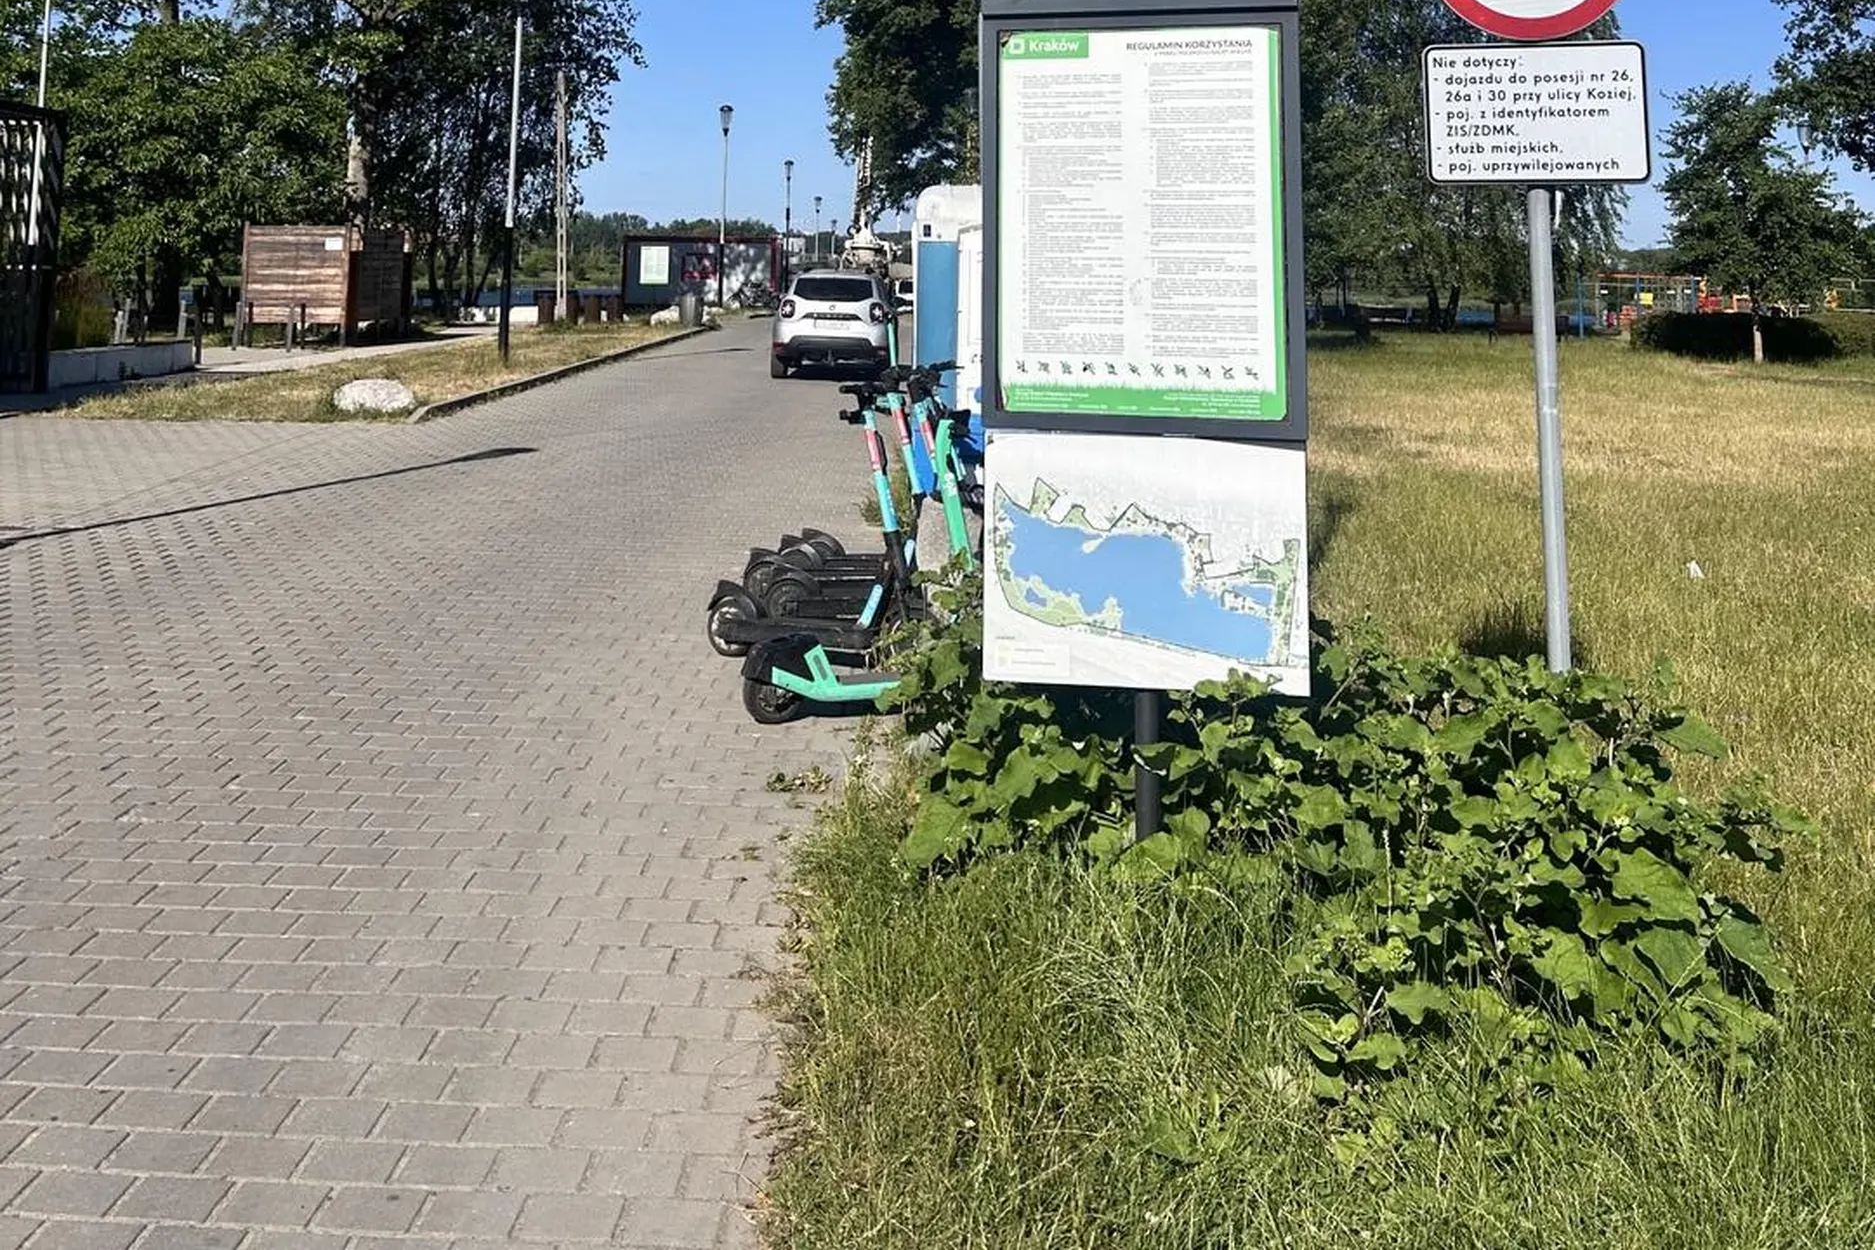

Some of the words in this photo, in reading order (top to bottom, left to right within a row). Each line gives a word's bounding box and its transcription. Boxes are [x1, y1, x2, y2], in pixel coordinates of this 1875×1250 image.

[1029, 37, 1079, 52] Kraków
[1126, 41, 1182, 50] REGULAMIN
[1184, 38, 1253, 50] KORZYSTANIA
[1432, 56, 1457, 68] Nie
[1463, 55, 1523, 70] dotyczy:
[1445, 73, 1503, 88] dojazdu
[1508, 72, 1527, 84] do
[1533, 70, 1584, 87] posesji
[1590, 73, 1605, 83] nr
[1445, 90, 1472, 102] 26a
[1488, 90, 1506, 101] 30
[1513, 92, 1541, 104] przy
[1548, 88, 1581, 103] ulicy
[1447, 108, 1474, 123] poj.
[1480, 110, 1487, 119] z
[1492, 106, 1610, 121] identyfikatorem
[1448, 141, 1485, 155] służb
[1449, 159, 1477, 174] poj.
[1482, 158, 1619, 174] uprzywilejowanych
